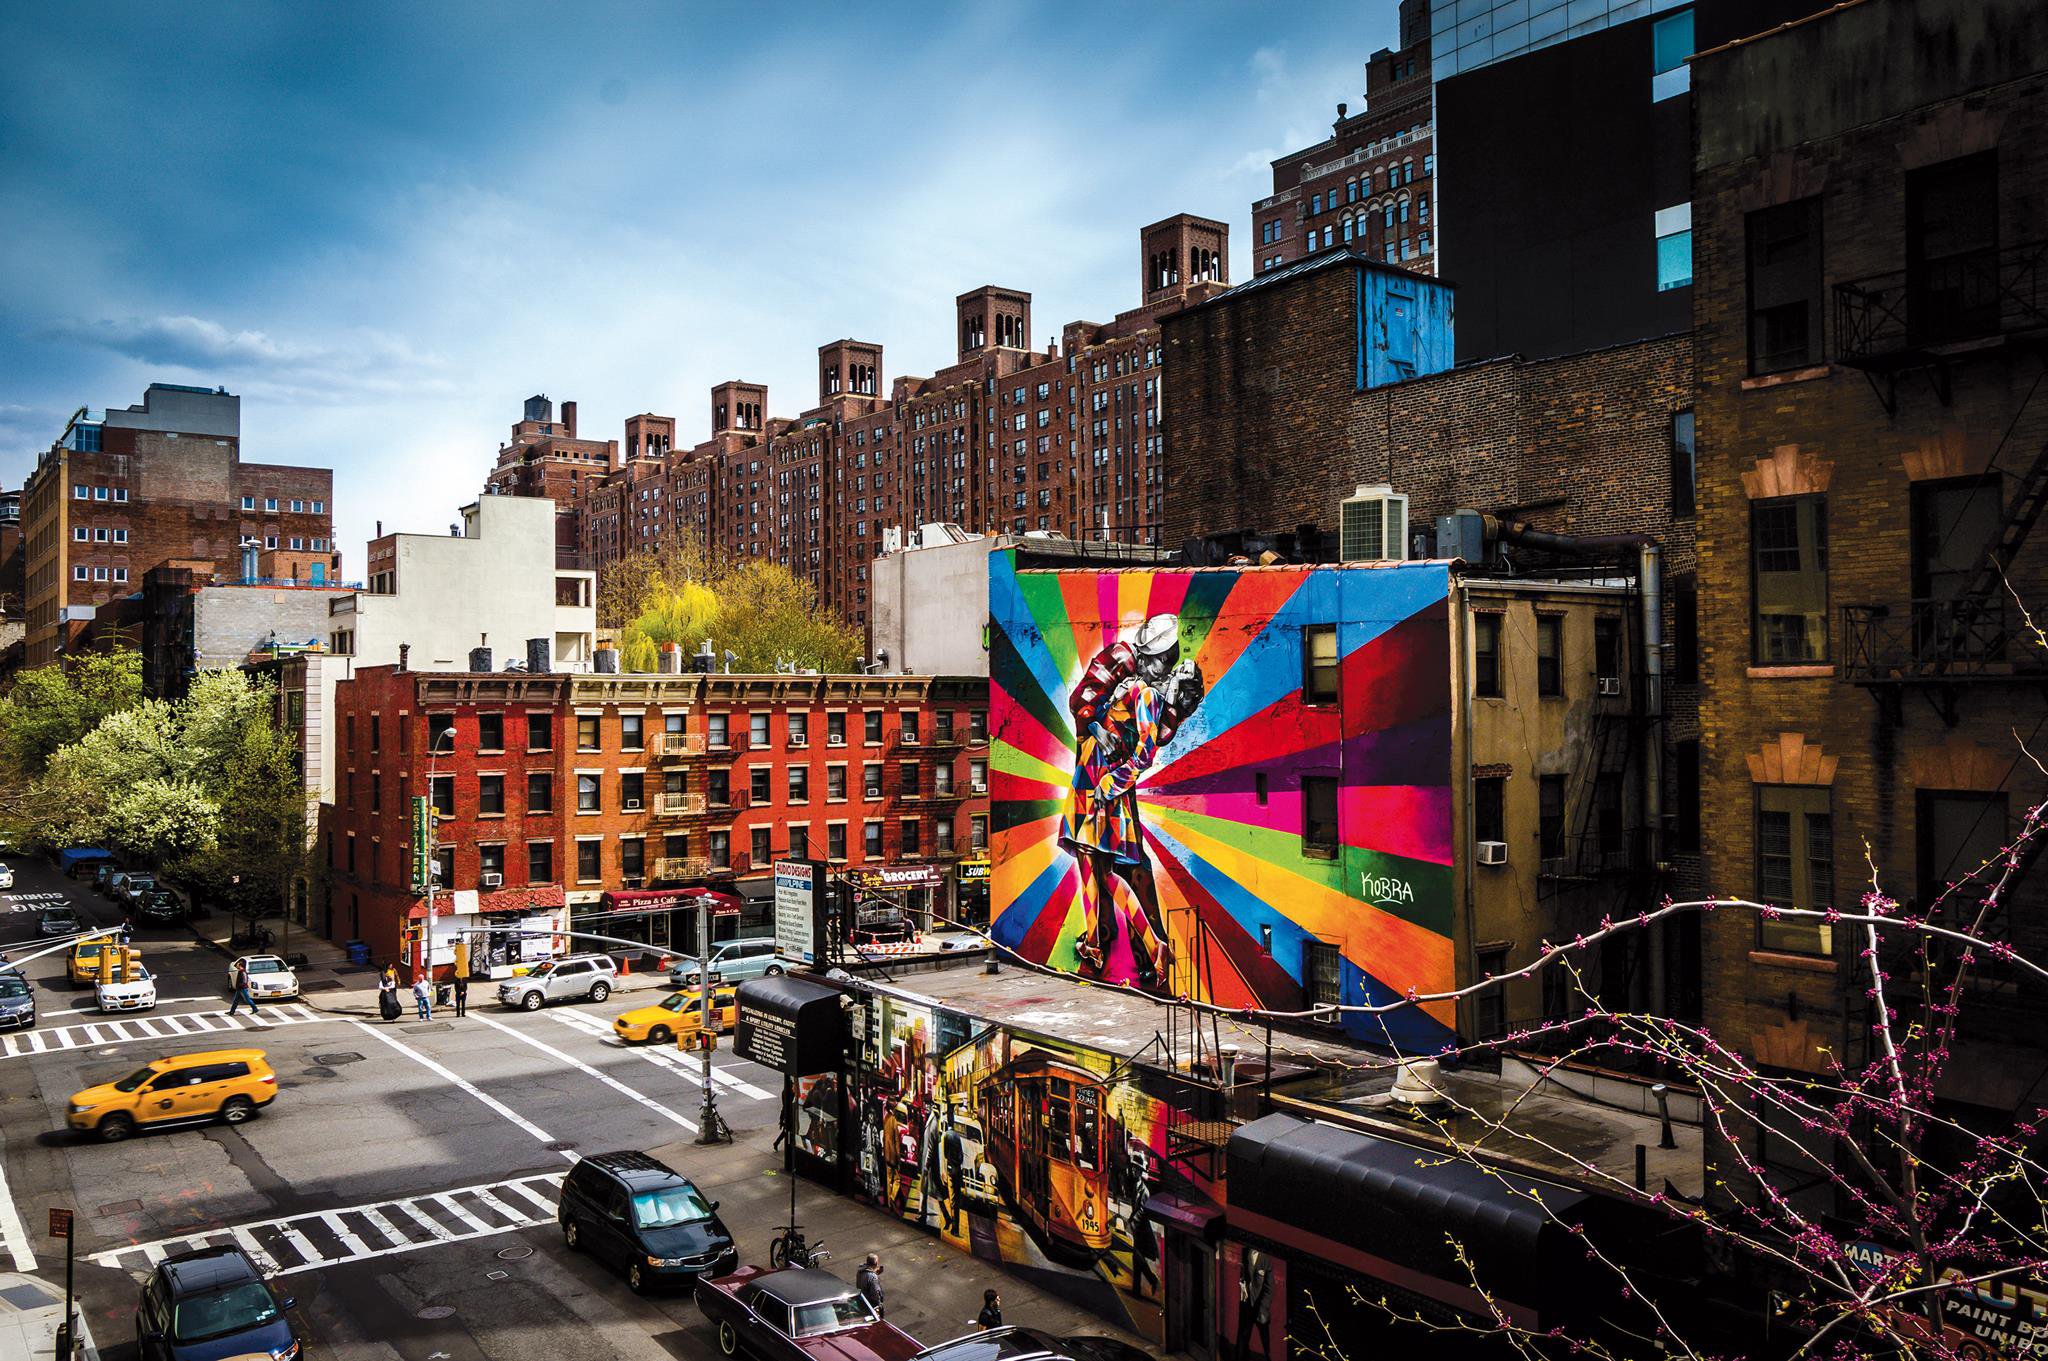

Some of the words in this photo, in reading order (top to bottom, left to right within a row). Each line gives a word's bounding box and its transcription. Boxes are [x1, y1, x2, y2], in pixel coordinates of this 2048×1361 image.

[776, 864, 791, 876] AUDIO
[792, 866, 811, 878] DESIGNS
[884, 870, 928, 882] GROCERY
[1361, 872, 1414, 902] KOBRA
[2, 892, 64, 902] SCHOOL
[632, 897, 652, 906] Pizza
[660, 896, 677, 904] Cafe
[1076, 1092, 1096, 1106] SQUARE
[1082, 1219, 1100, 1232] 1945
[1946, 1300, 2012, 1328] PAINT
